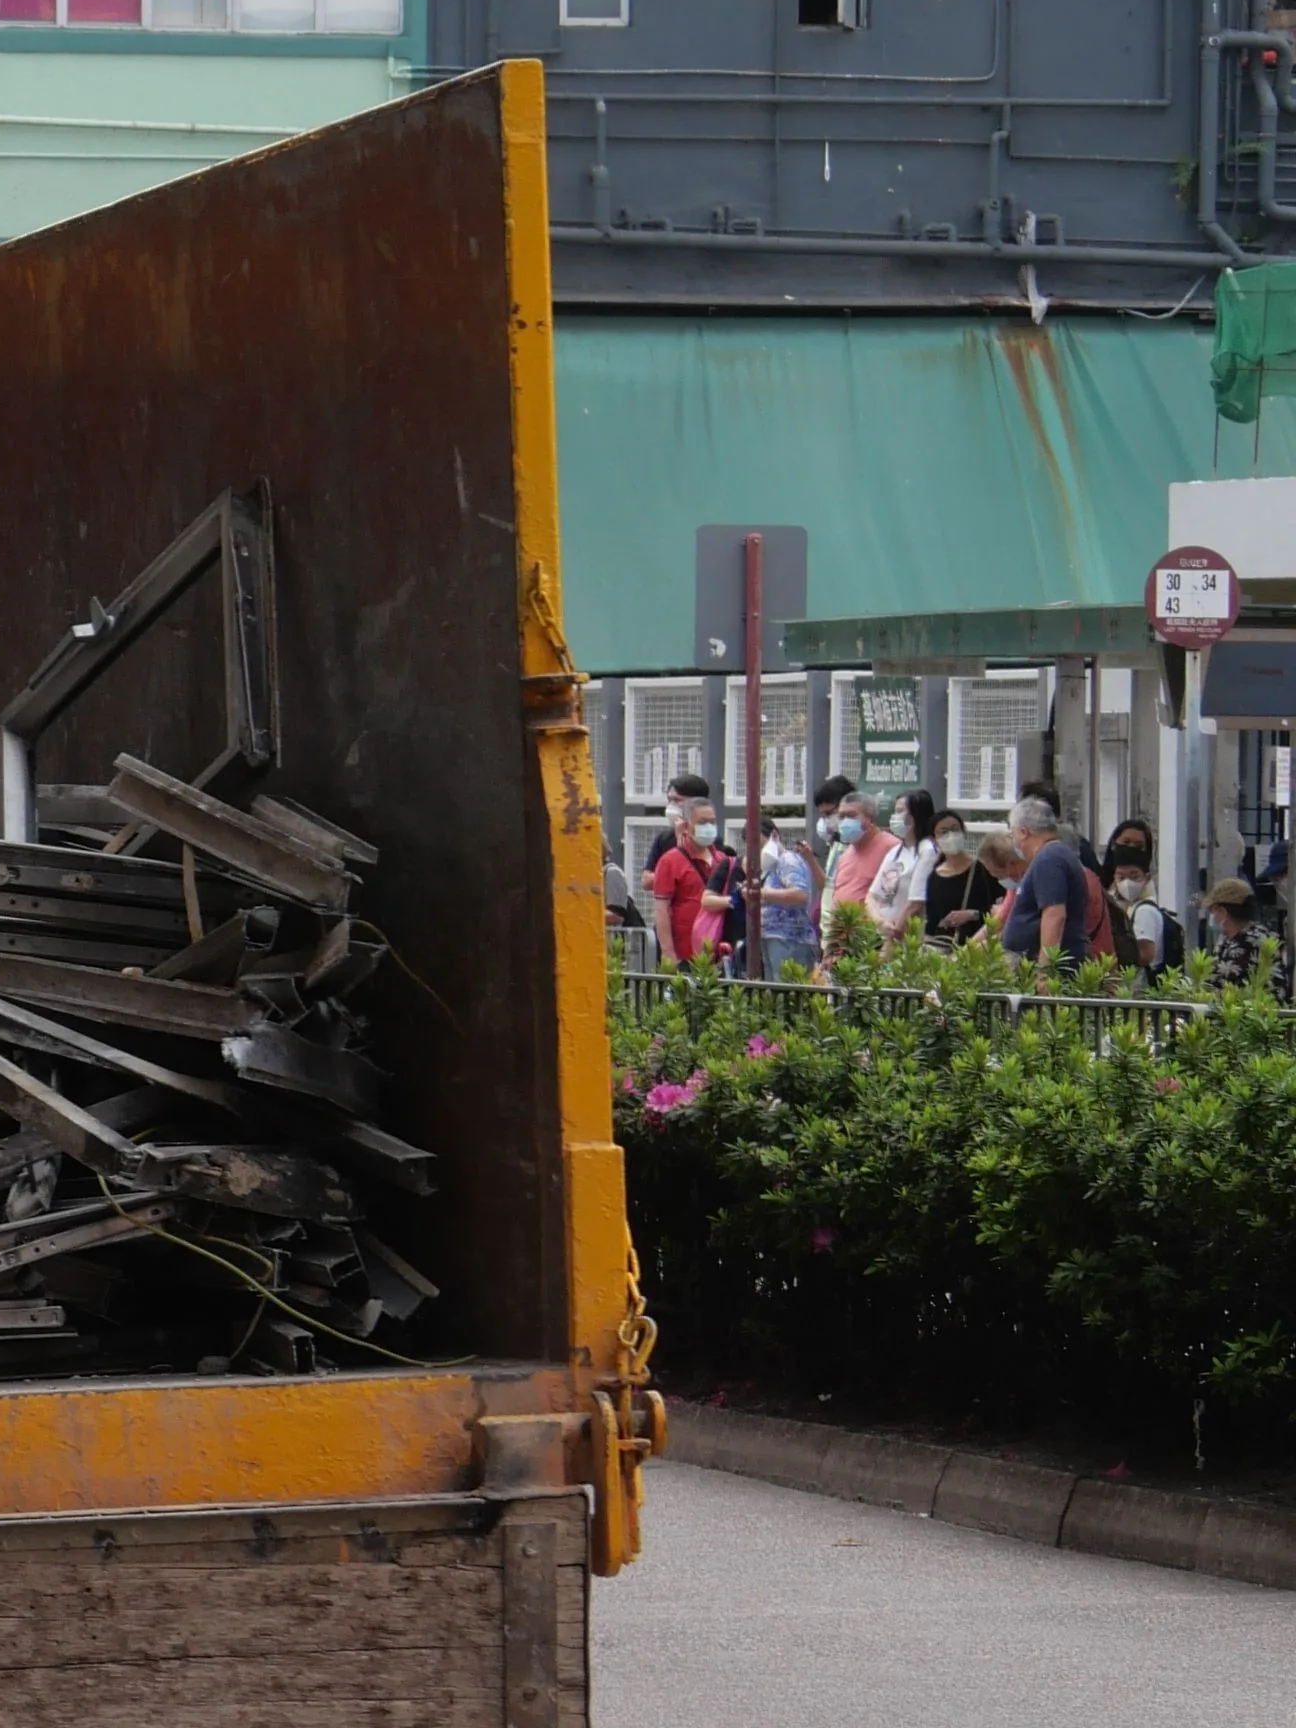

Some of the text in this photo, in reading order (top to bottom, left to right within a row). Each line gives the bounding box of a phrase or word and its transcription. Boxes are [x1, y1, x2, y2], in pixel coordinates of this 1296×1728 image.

[1166, 573, 1217, 591] 30 34
[1165, 597, 1180, 614] 43
